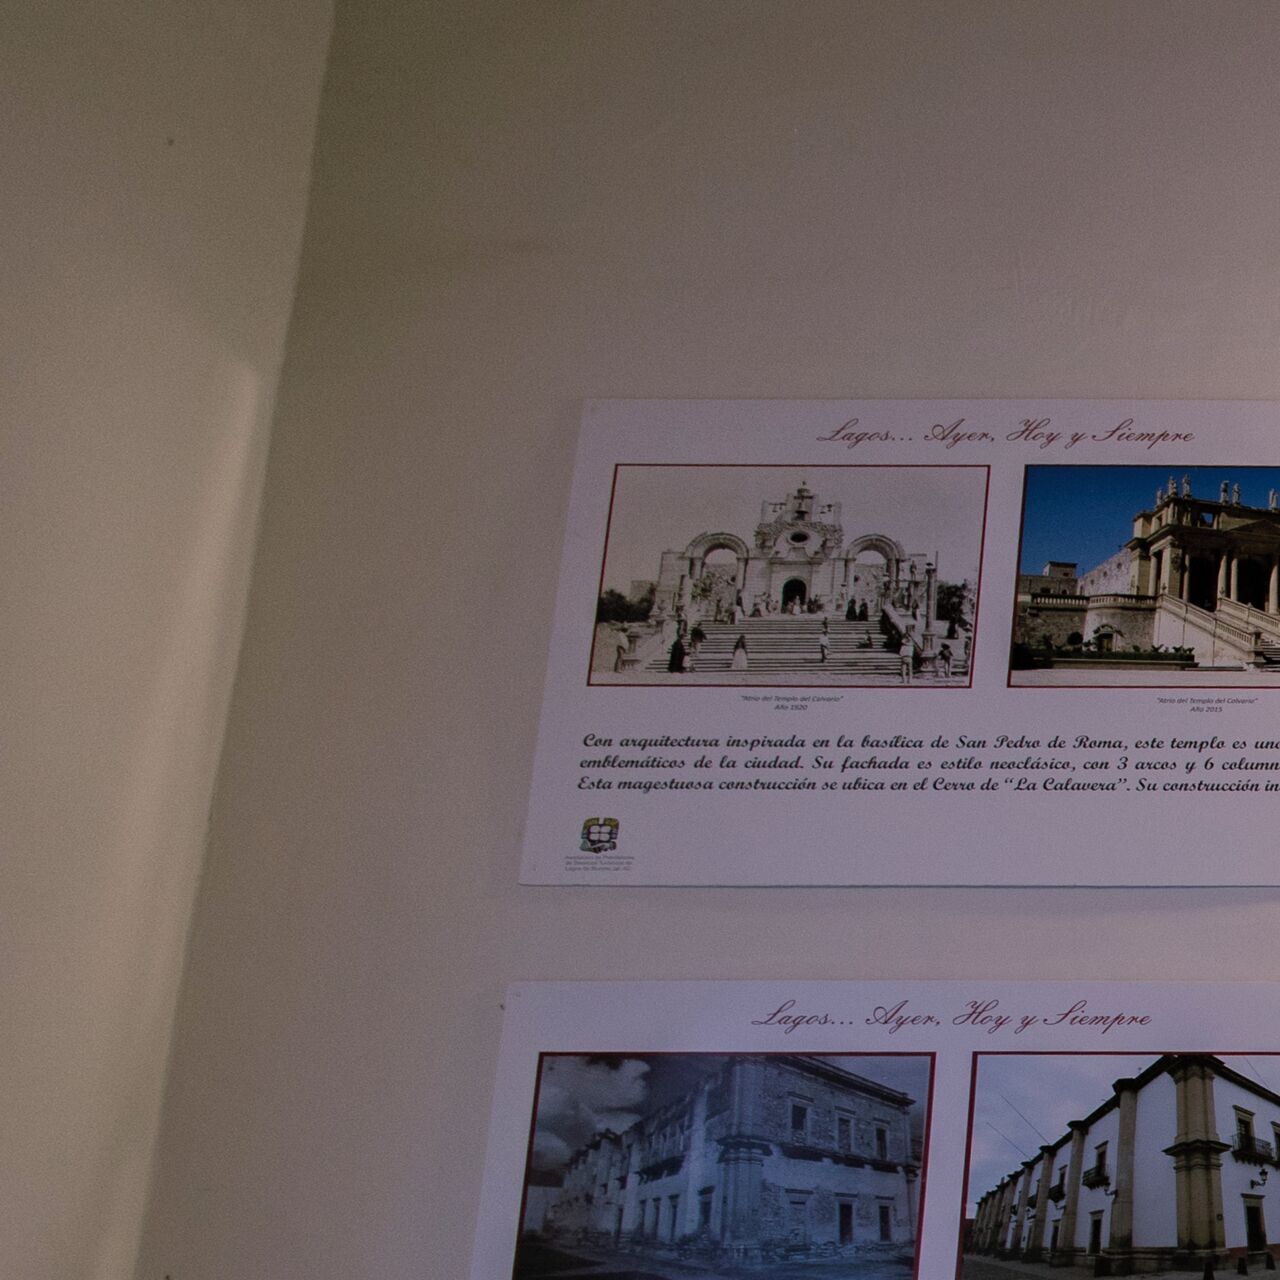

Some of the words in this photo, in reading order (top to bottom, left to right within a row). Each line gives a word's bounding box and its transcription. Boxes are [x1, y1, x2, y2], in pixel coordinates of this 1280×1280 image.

[816, 418, 913, 449] Lagos...
[923, 418, 995, 449] Ayer,
[1006, 418, 1063, 450] Hoy
[1064, 432, 1087, 450] y
[1093, 418, 1195, 450] Siempre
[577, 776, 612, 790] Esta
[617, 778, 713, 794] magestuosa
[718, 777, 816, 790] construcción
[821, 781, 837, 790] se
[842, 777, 885, 790] ubica
[890, 782, 907, 791] en
[913, 777, 928, 791] el
[932, 777, 975, 791] Cerro
[980, 777, 999, 791] de
[1004, 777, 1037, 791] “La
[1042, 777, 1130, 791] Calavera”.
[1135, 778, 1157, 791] Su
[1162, 779, 1260, 792] construcción
[751, 999, 853, 1034] Lagos...
[865, 1000, 940, 1034] Ayer,
[952, 999, 1013, 1034] Hoy
[1014, 1014, 1038, 1034] y
[1043, 999, 1152, 1034] Siempre
